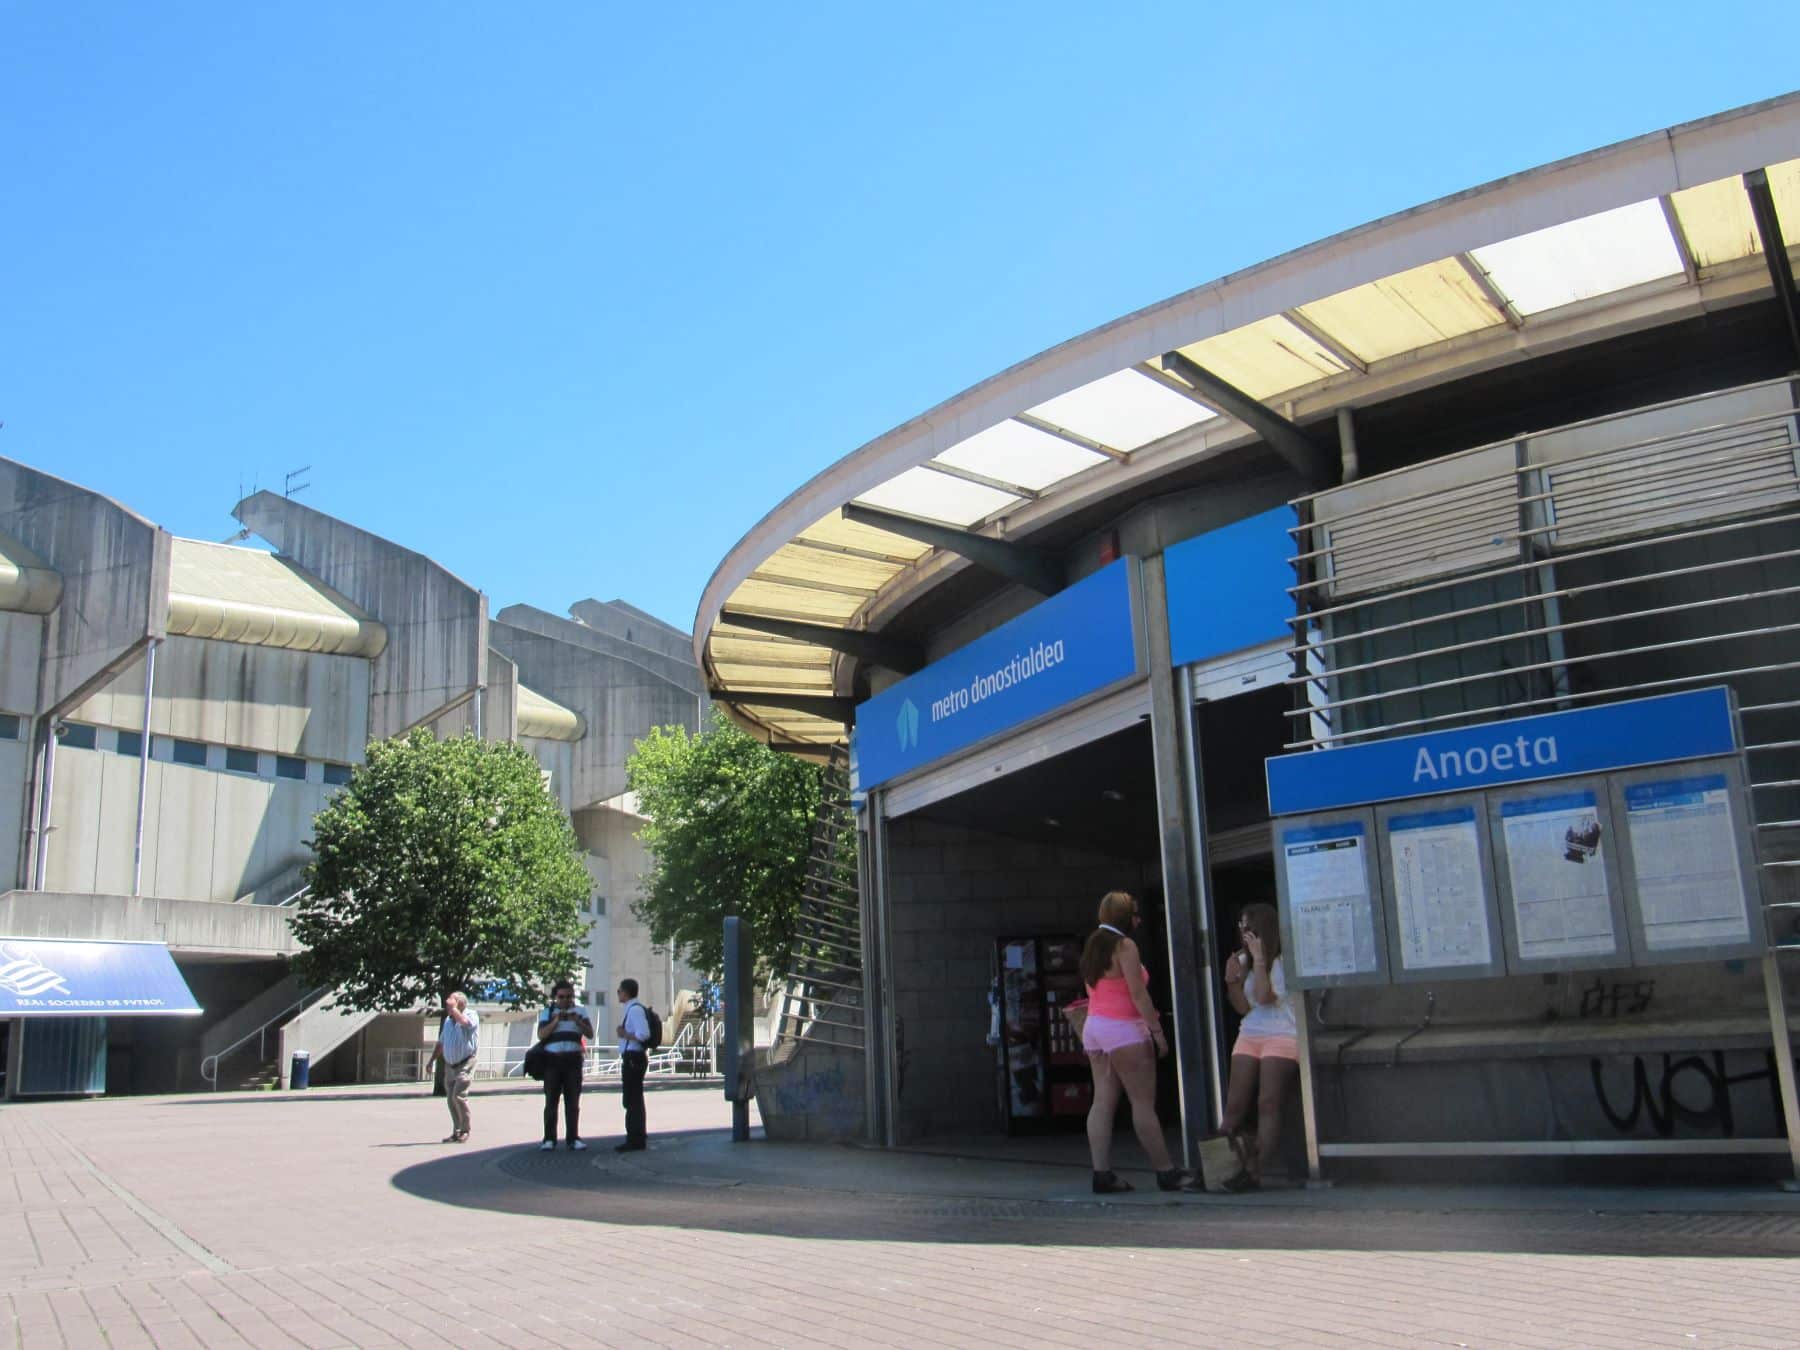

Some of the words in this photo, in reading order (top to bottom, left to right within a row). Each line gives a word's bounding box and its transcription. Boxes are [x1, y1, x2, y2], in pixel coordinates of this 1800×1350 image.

[931, 688, 969, 723] metro
[971, 639, 1065, 703] donostialdea
[1413, 735, 1559, 782] Anoeta
[47, 999, 105, 1007] SOCIEDAD
